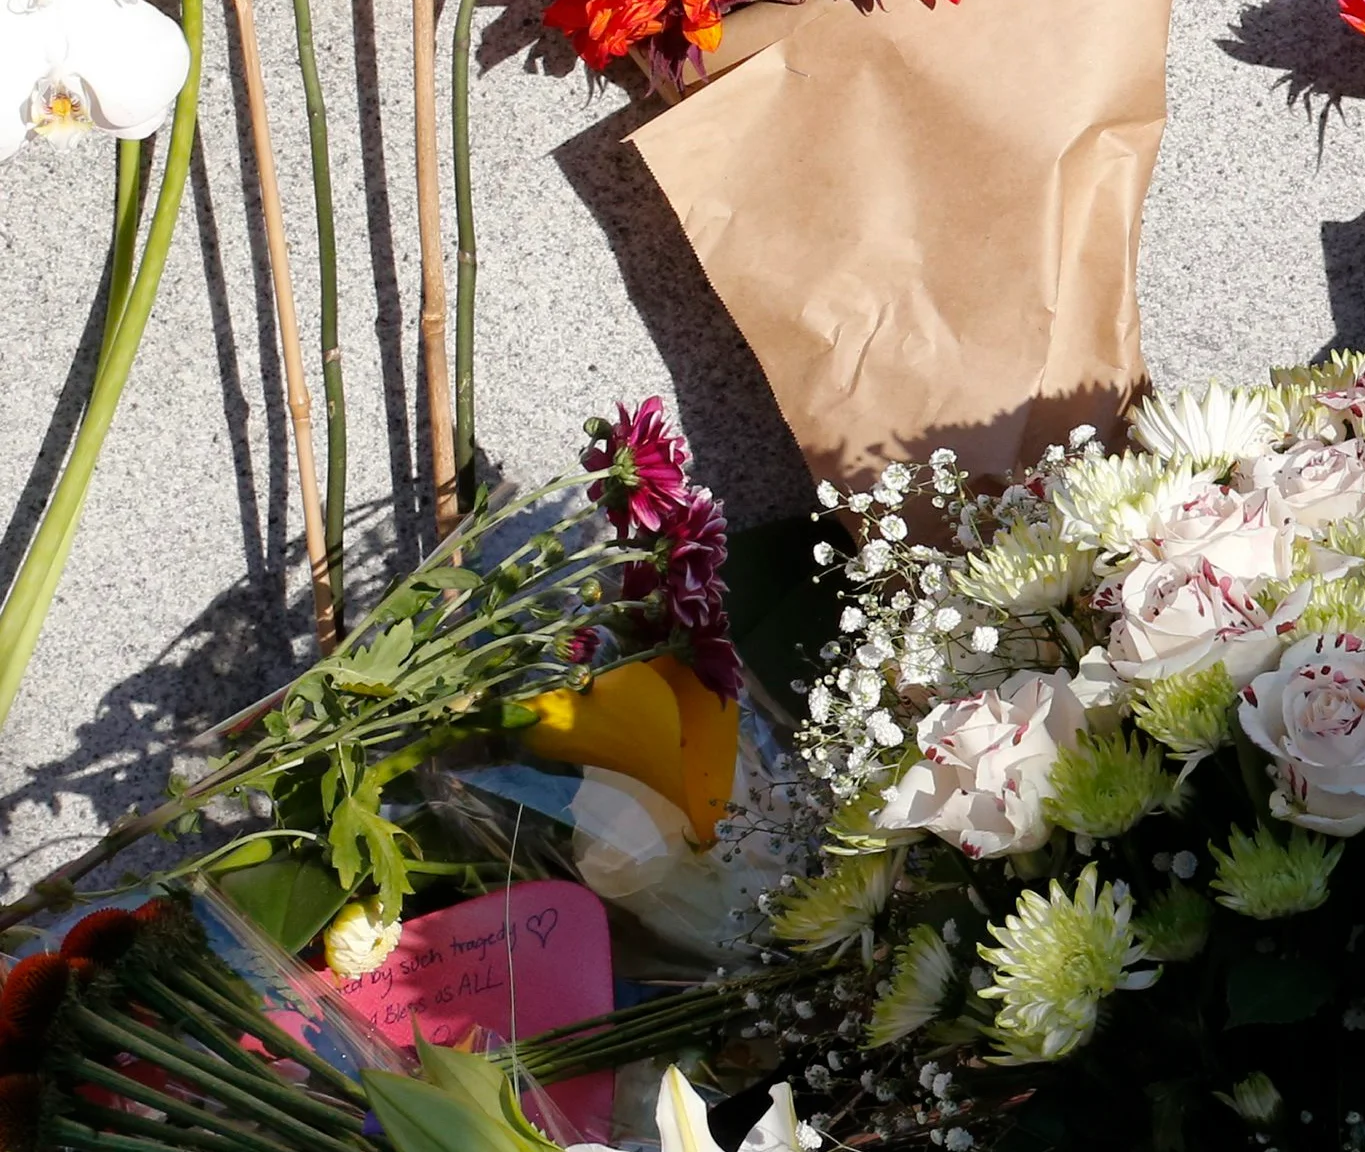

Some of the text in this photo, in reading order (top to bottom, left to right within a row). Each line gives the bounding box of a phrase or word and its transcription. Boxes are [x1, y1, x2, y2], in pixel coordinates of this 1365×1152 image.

[371, 965, 393, 999] by
[400, 948, 443, 975] such
[451, 921, 517, 962] tragedy
[384, 998, 426, 1025] Bless
[458, 964, 504, 996] ALL
